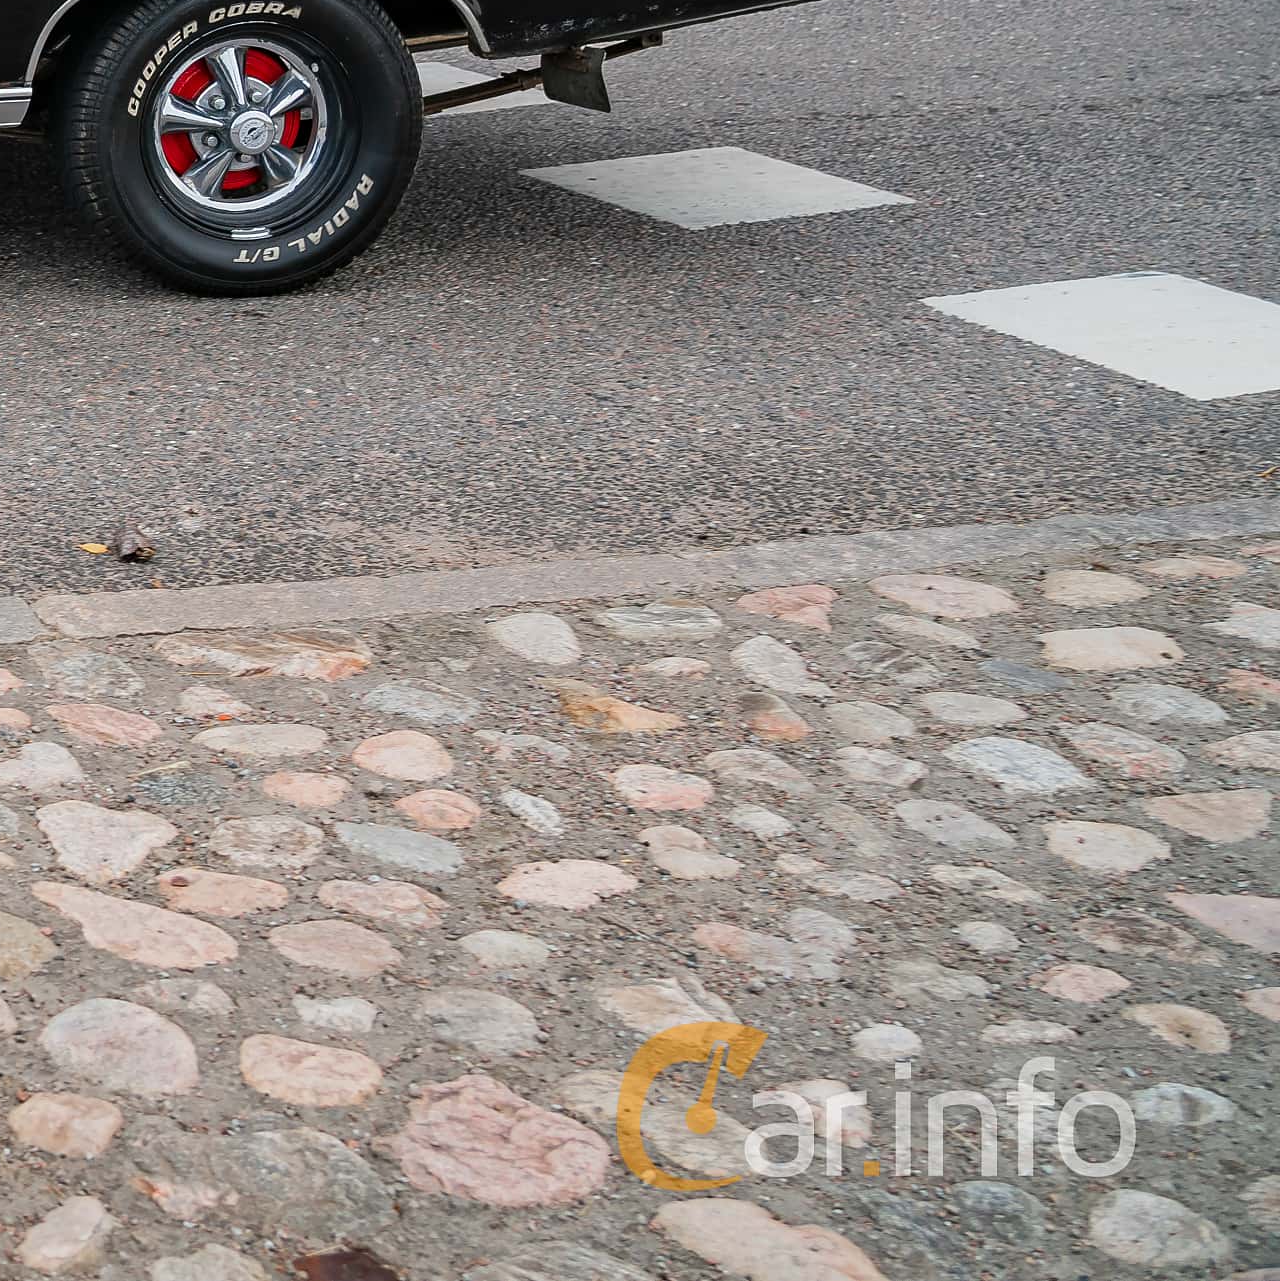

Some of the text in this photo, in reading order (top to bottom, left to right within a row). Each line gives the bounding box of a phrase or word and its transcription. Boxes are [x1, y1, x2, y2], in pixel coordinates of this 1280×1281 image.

[126, 0, 302, 119] COOPER COBRA
[233, 172, 376, 265] RADIAL G/T
